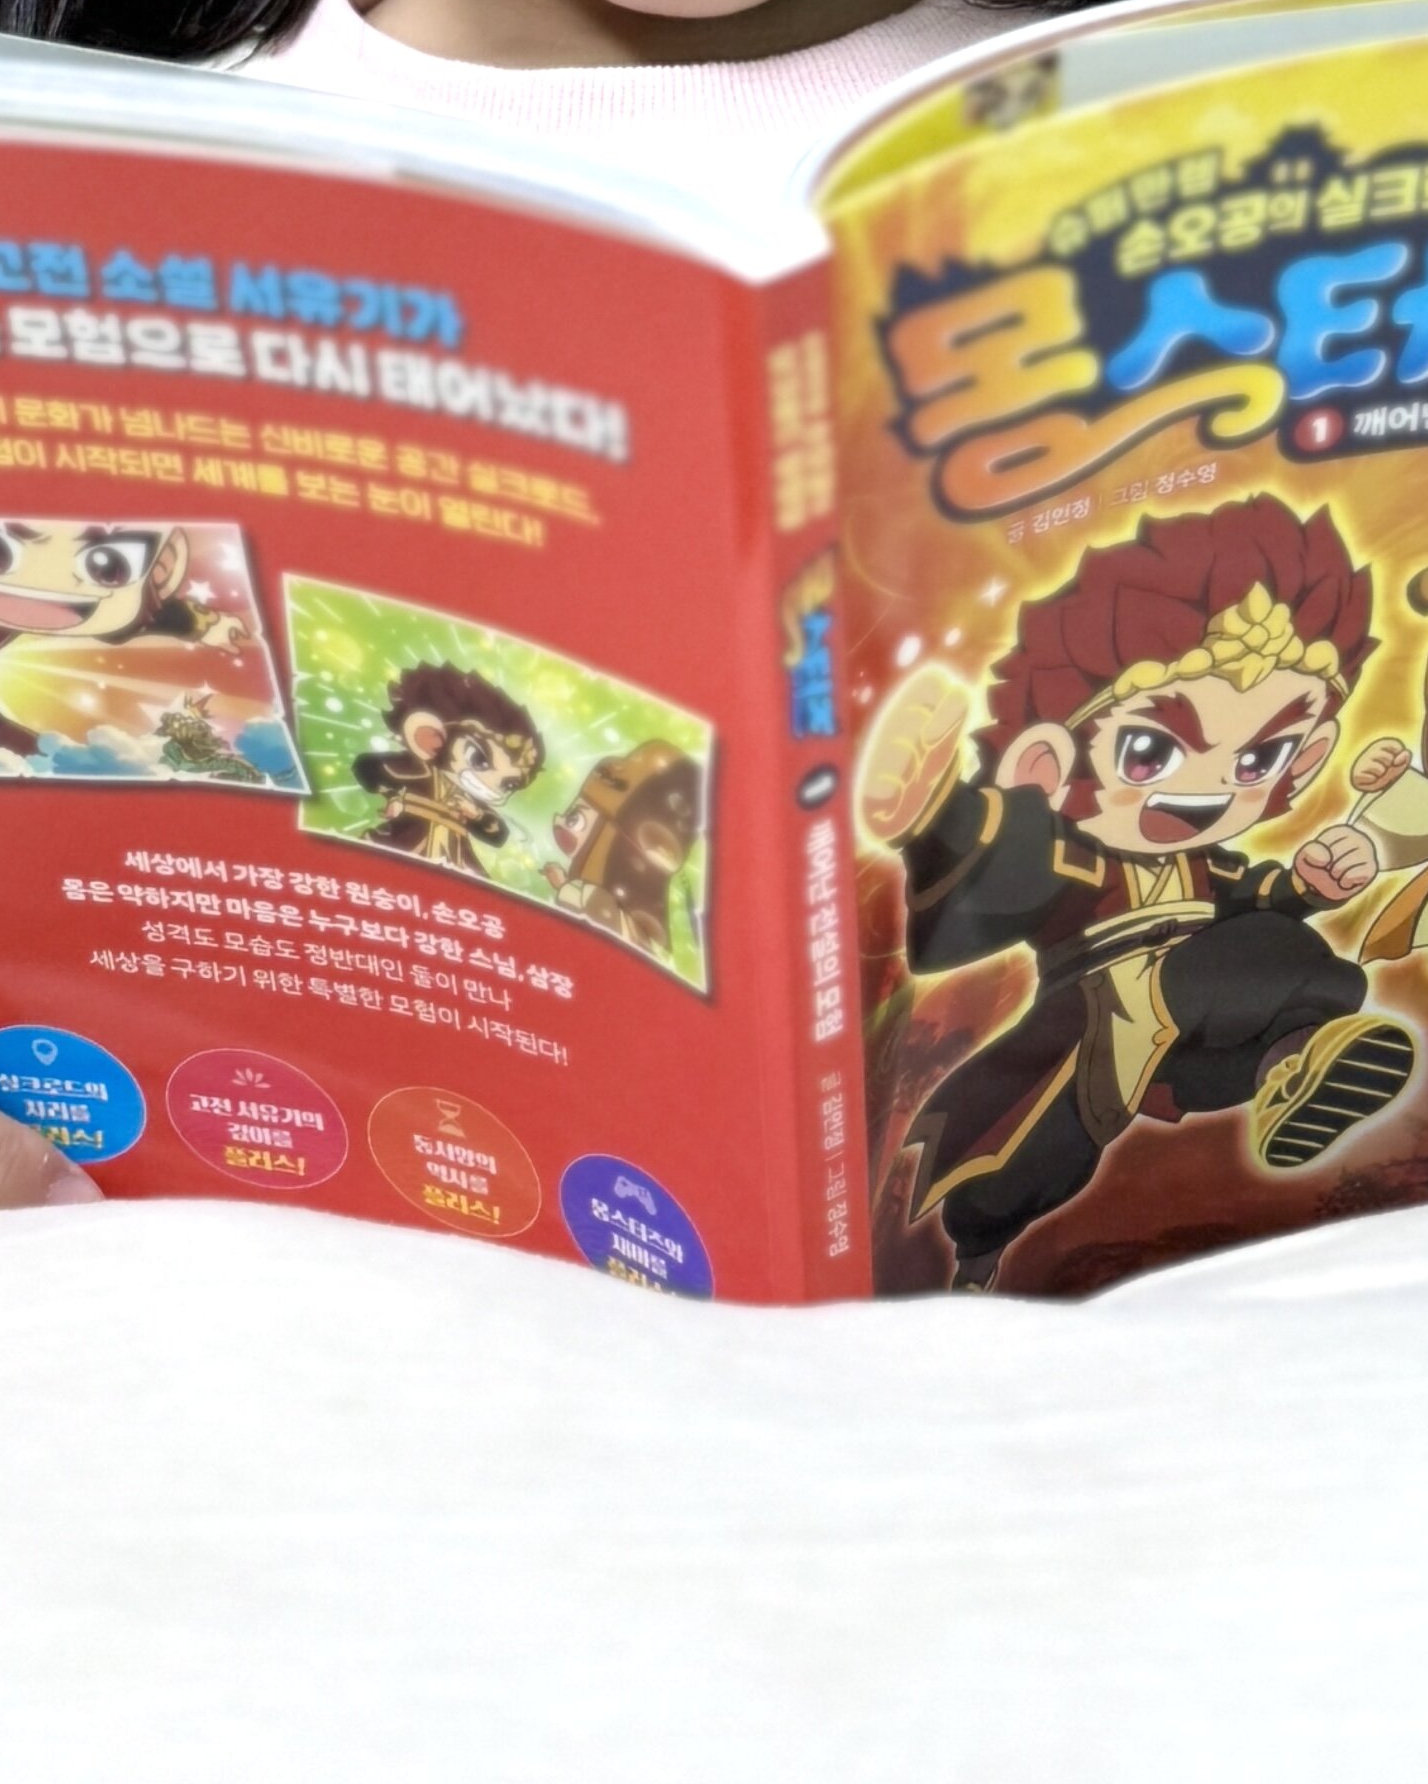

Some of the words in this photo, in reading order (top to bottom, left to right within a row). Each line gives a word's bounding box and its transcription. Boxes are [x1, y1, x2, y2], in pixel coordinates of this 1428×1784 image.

[1117, 189, 1309, 276] 손오공의
[100, 248, 217, 309] 소설
[228, 260, 464, 348] 서유기가
[8, 305, 246, 376] 모험으로
[250, 328, 371, 398] 다시
[377, 348, 629, 463] 태어났다!
[14, 395, 112, 433] 문화가
[120, 406, 251, 449] 넘나드는
[260, 424, 388, 471] 신비로운
[396, 444, 460, 485] 공간
[1156, 463, 1217, 494] 정수영
[56, 443, 184, 481] 시작되면
[193, 456, 288, 497] 세계를
[296, 471, 359, 507] 보는
[368, 483, 430, 520] 눈이
[440, 495, 544, 547] 열린다!
[125, 851, 228, 882] 세상에서
[232, 864, 284, 890] 가장
[289, 872, 340, 899] 강한
[346, 881, 428, 919] 원숭이,
[432, 902, 505, 939] 손오공
[806, 821, 836, 905] 깨어난
[62, 878, 113, 902] 몸은
[117, 884, 221, 916] 약하지만
[226, 898, 302, 927] 마음은
[309, 910, 409, 948] 누구보다
[414, 931, 464, 963] 강한
[469, 949, 524, 982] 스님,
[527, 965, 574, 998] 삼장
[142, 921, 218, 947] 성격도
[224, 932, 300, 959] 모습도
[304, 944, 404, 982] 정반대인
[410, 965, 457, 995] 둘이
[464, 979, 511, 1011] 만나
[810, 903, 840, 985] 전설의
[90, 950, 165, 976] 세상을
[171, 958, 247, 986] 구하기
[253, 969, 302, 995] 위한
[308, 978, 382, 1010] 특별한
[390, 995, 461, 1030] 모험이
[468, 1016, 568, 1066] 시작된다!
[815, 984, 842, 1043] 모험
[190, 1094, 232, 1117] 고전
[237, 1098, 324, 1131] 서유기의
[228, 1123, 293, 1149] 깊이를
[225, 1146, 306, 1175] 플러스!
[413, 1134, 497, 1175] 동서양의
[427, 1161, 488, 1195] 역사를
[826, 1165, 848, 1200] 그림
[424, 1183, 500, 1225] 플러스!
[828, 1202, 849, 1257] 정수영
